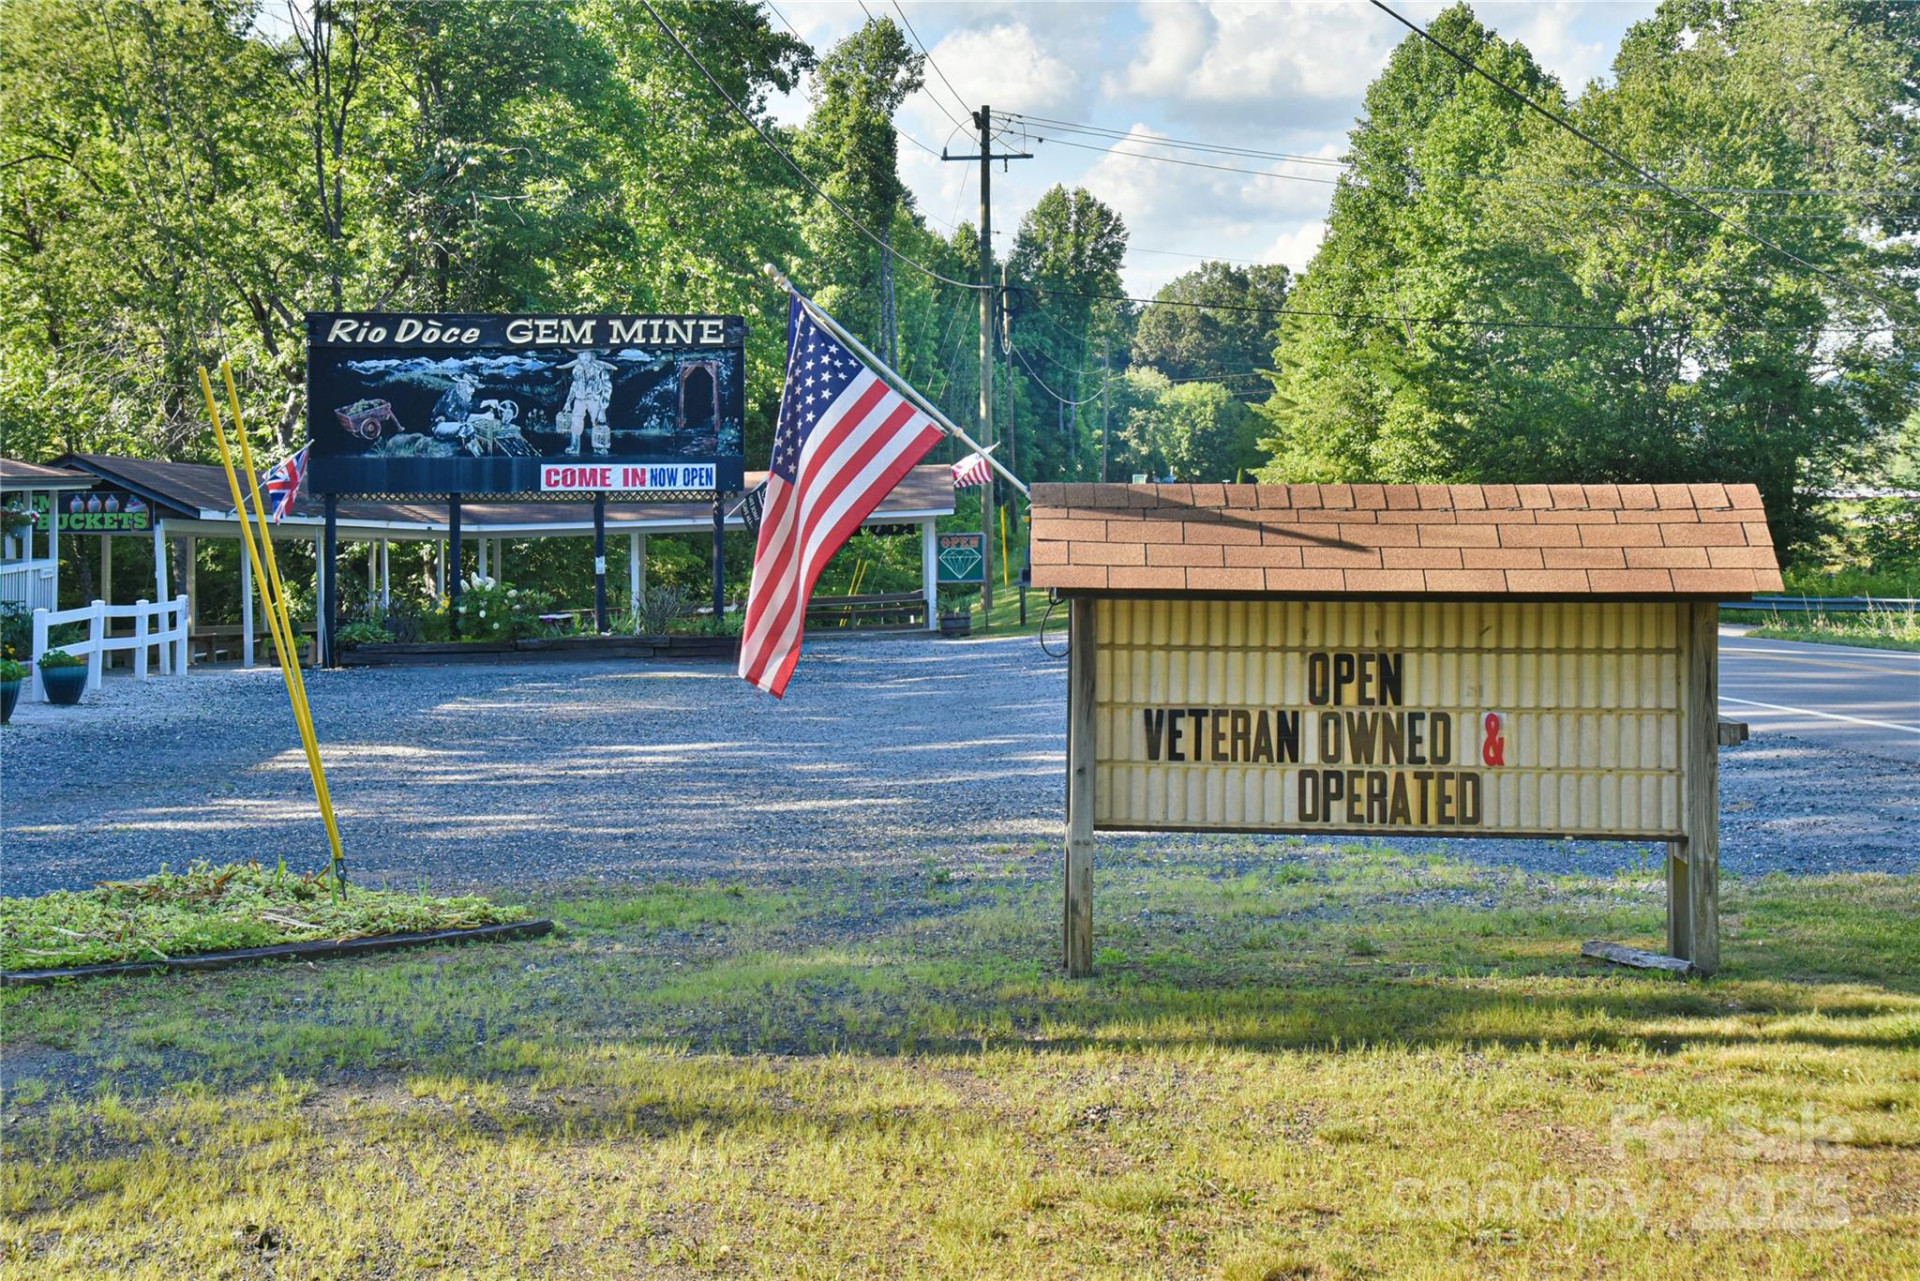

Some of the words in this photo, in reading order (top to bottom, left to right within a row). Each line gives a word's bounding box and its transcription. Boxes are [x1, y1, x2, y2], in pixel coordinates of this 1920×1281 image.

[327, 318, 387, 343] Rio
[394, 318, 481, 343] Dòce
[506, 318, 596, 344] GEM
[608, 318, 724, 344] MINE
[545, 467, 612, 488] COME
[622, 468, 646, 487] IN
[650, 467, 678, 487] NOW
[683, 466, 713, 487] OPEN
[36, 513, 147, 529] BUCKETS
[940, 536, 979, 549] OPEN
[1308, 652, 1402, 706] OPEN
[1144, 708, 1299, 763] VETERAN
[1320, 711, 1451, 765] OWNED
[1482, 712, 1505, 767] &
[1298, 769, 1481, 826] OPERATED
